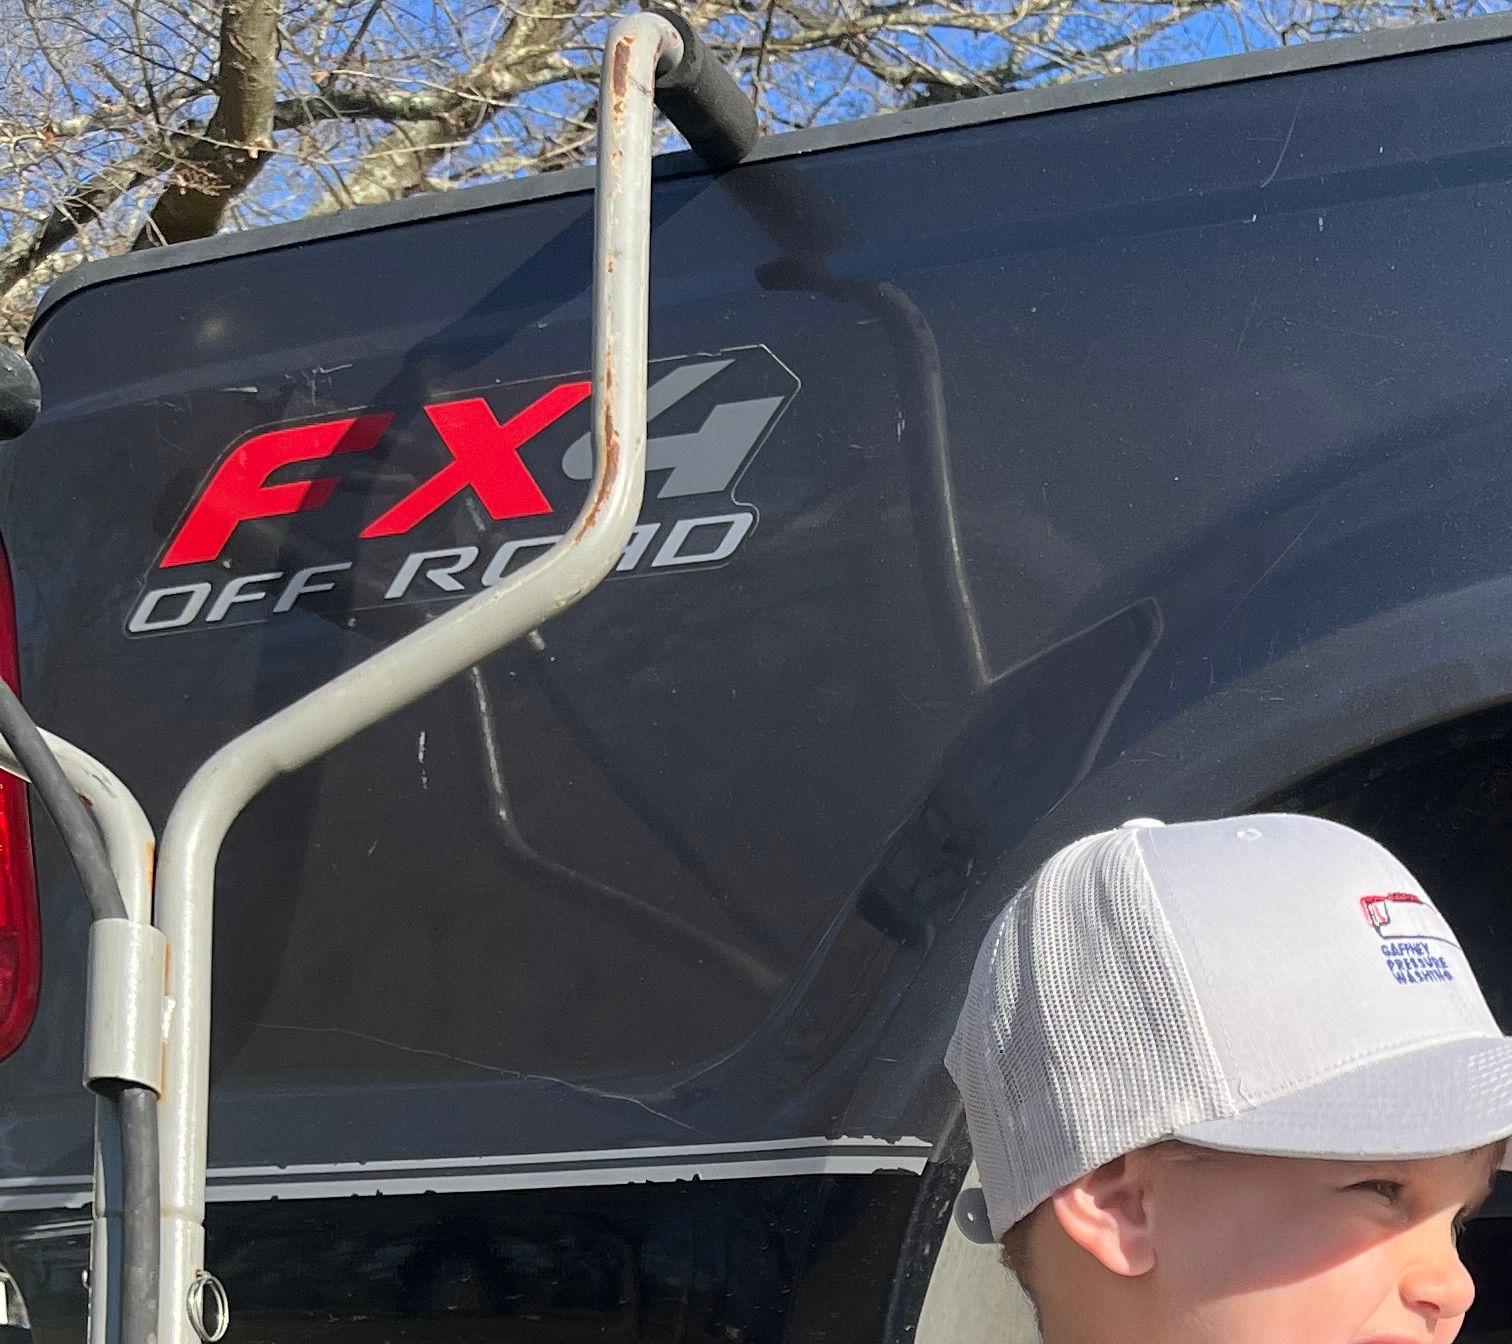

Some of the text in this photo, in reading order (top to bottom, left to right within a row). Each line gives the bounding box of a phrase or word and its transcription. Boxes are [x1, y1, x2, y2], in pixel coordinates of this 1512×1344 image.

[159, 358, 785, 568] FX4
[127, 561, 352, 634] OFF
[1386, 956, 1449, 971] PRESSURE
